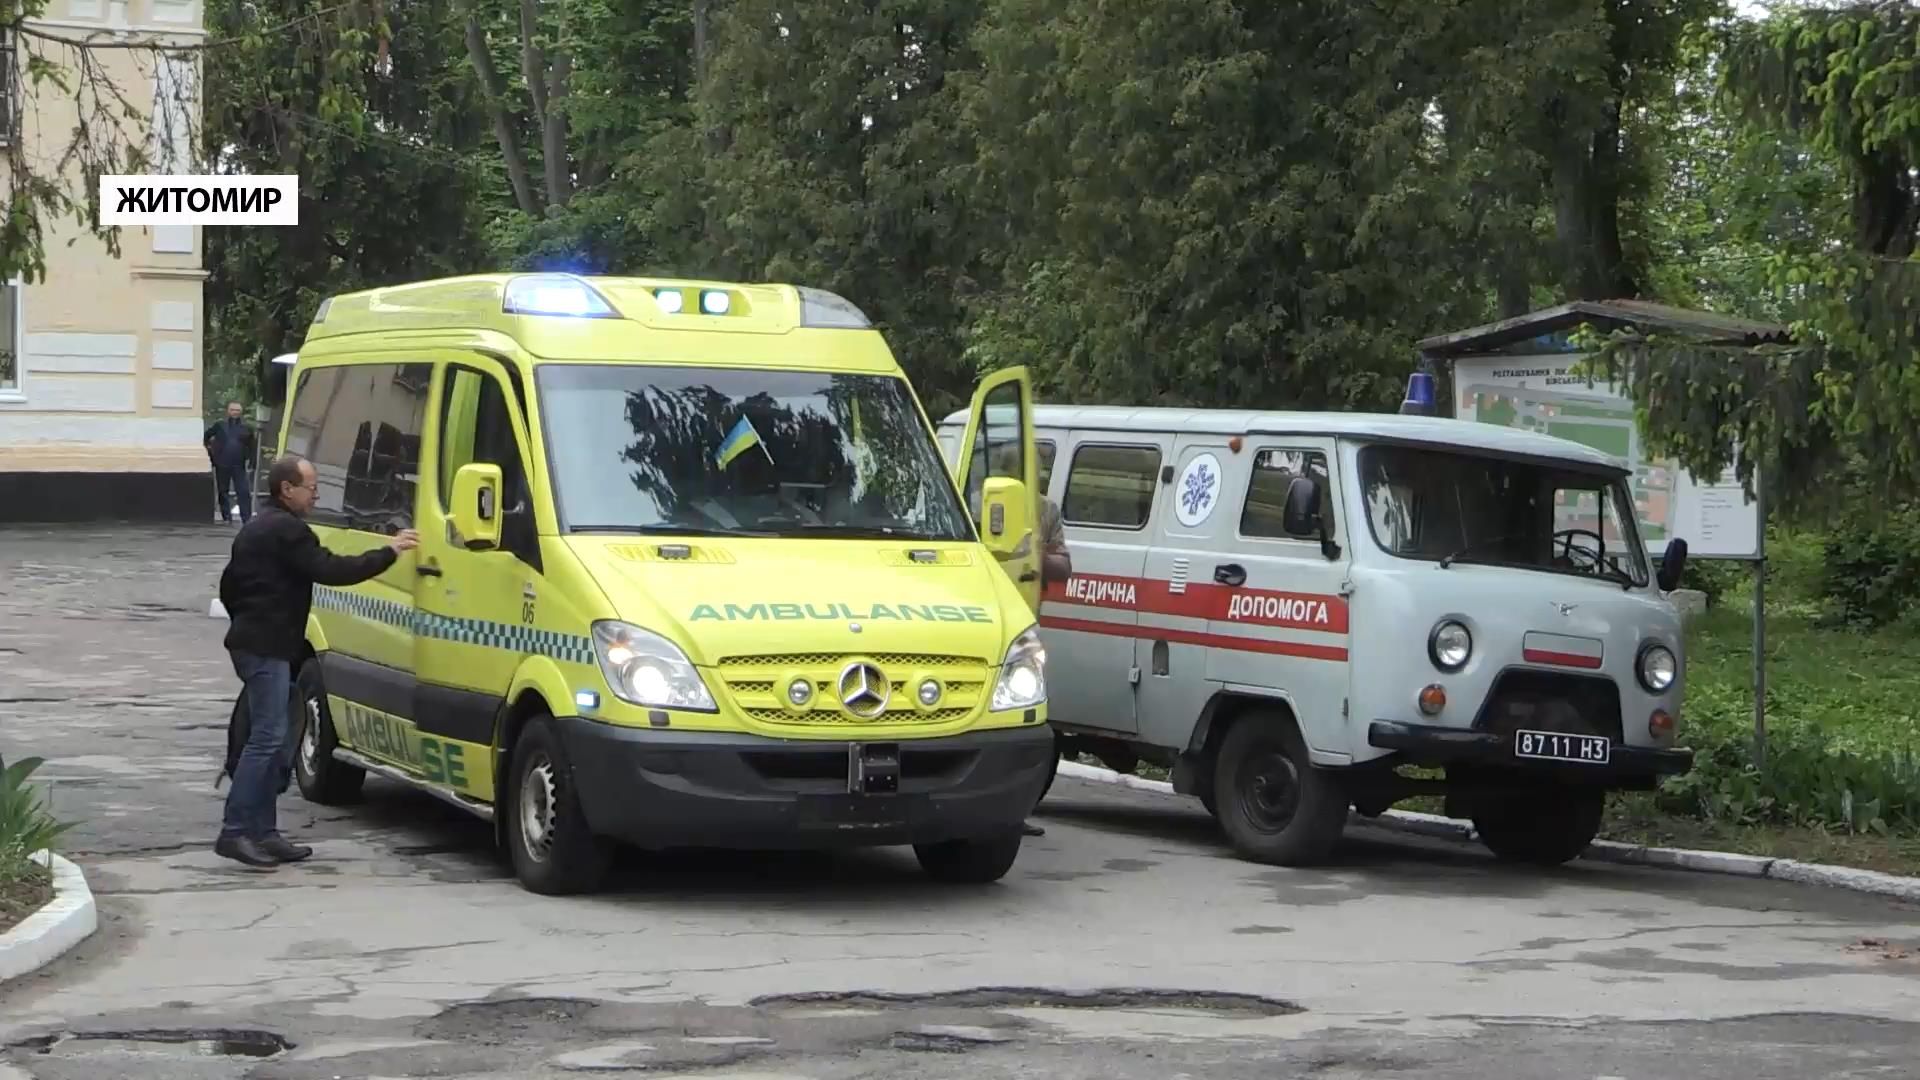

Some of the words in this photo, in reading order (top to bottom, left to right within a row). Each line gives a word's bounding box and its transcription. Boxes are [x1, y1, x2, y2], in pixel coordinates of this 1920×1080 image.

[1065, 577, 1136, 604] МЕДИЧНА
[1227, 594, 1328, 624] ДОПОМОГА
[522, 601, 535, 624] 06
[690, 603, 993, 624] AMBULANSE
